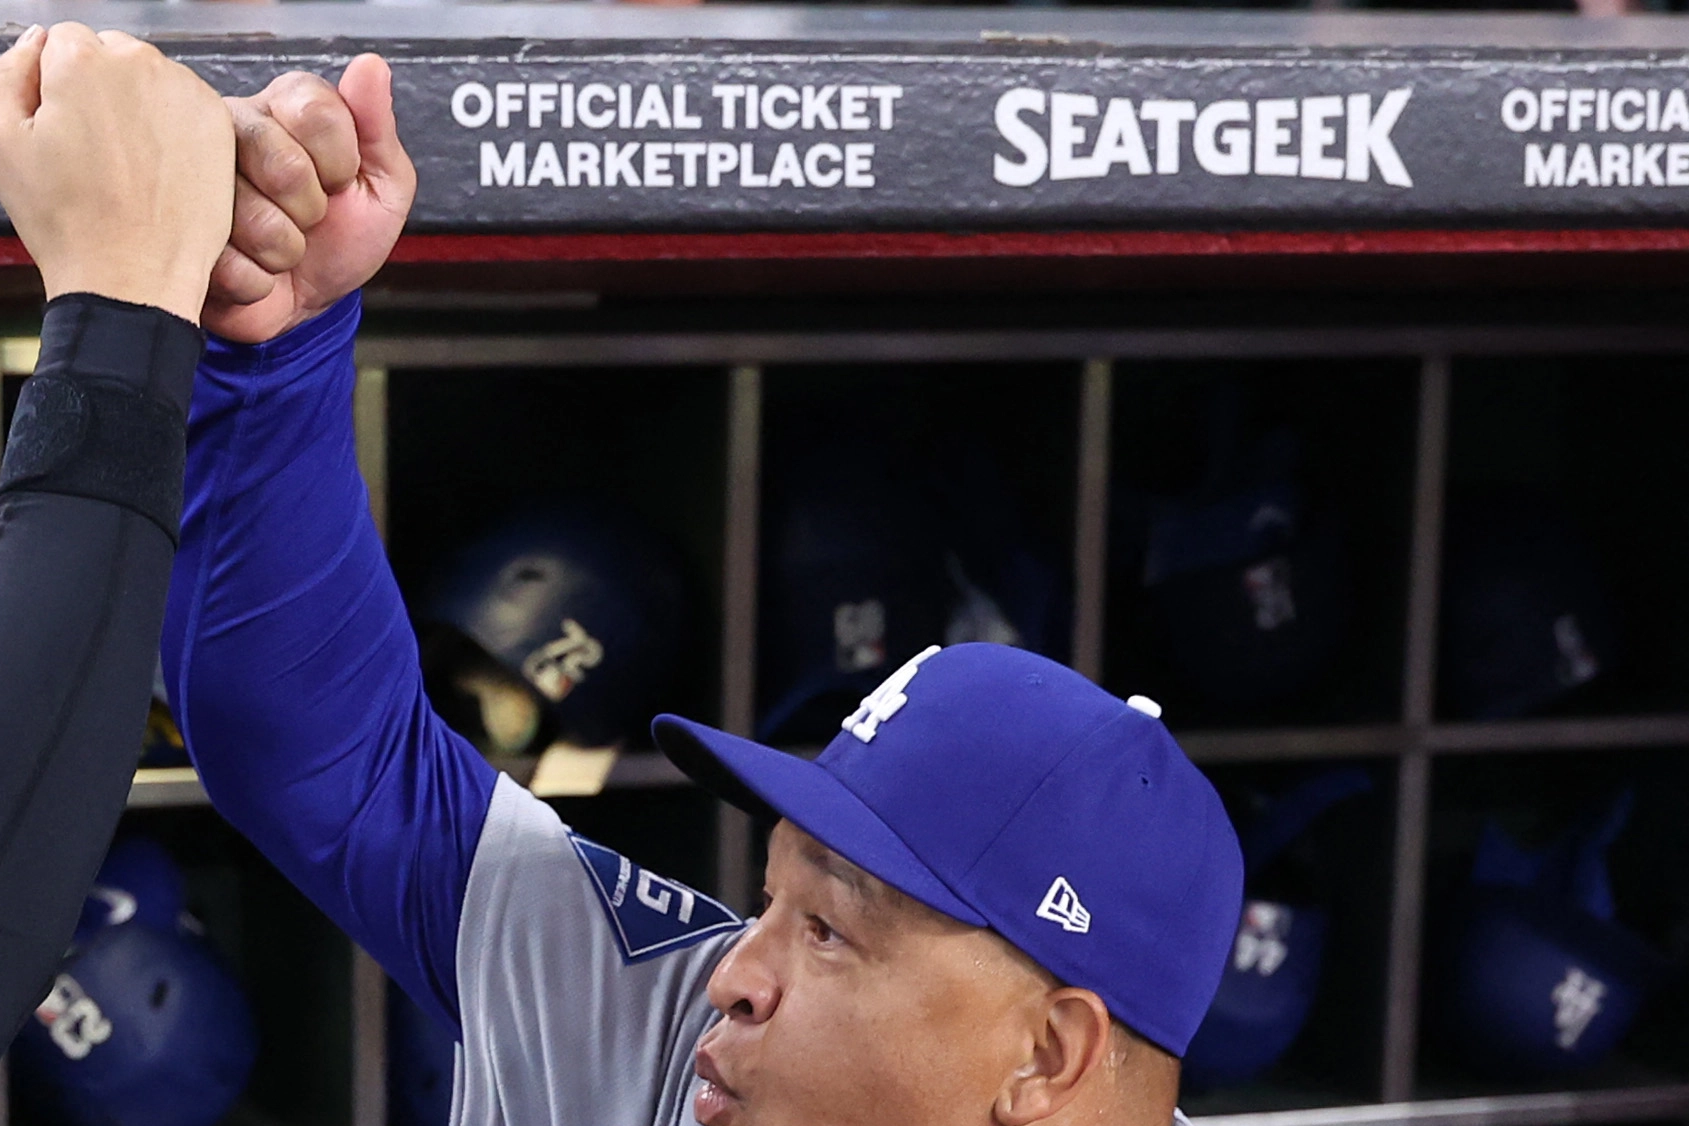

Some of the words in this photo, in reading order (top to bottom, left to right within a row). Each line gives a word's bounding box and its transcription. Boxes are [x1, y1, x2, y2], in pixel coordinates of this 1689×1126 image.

[450, 82, 702, 130] OFFICIAL
[711, 84, 904, 131] TICKET
[993, 85, 1414, 188] SEATGEEK
[479, 141, 875, 188] MARKETPLACE
[1524, 142, 1689, 187] MARKE
